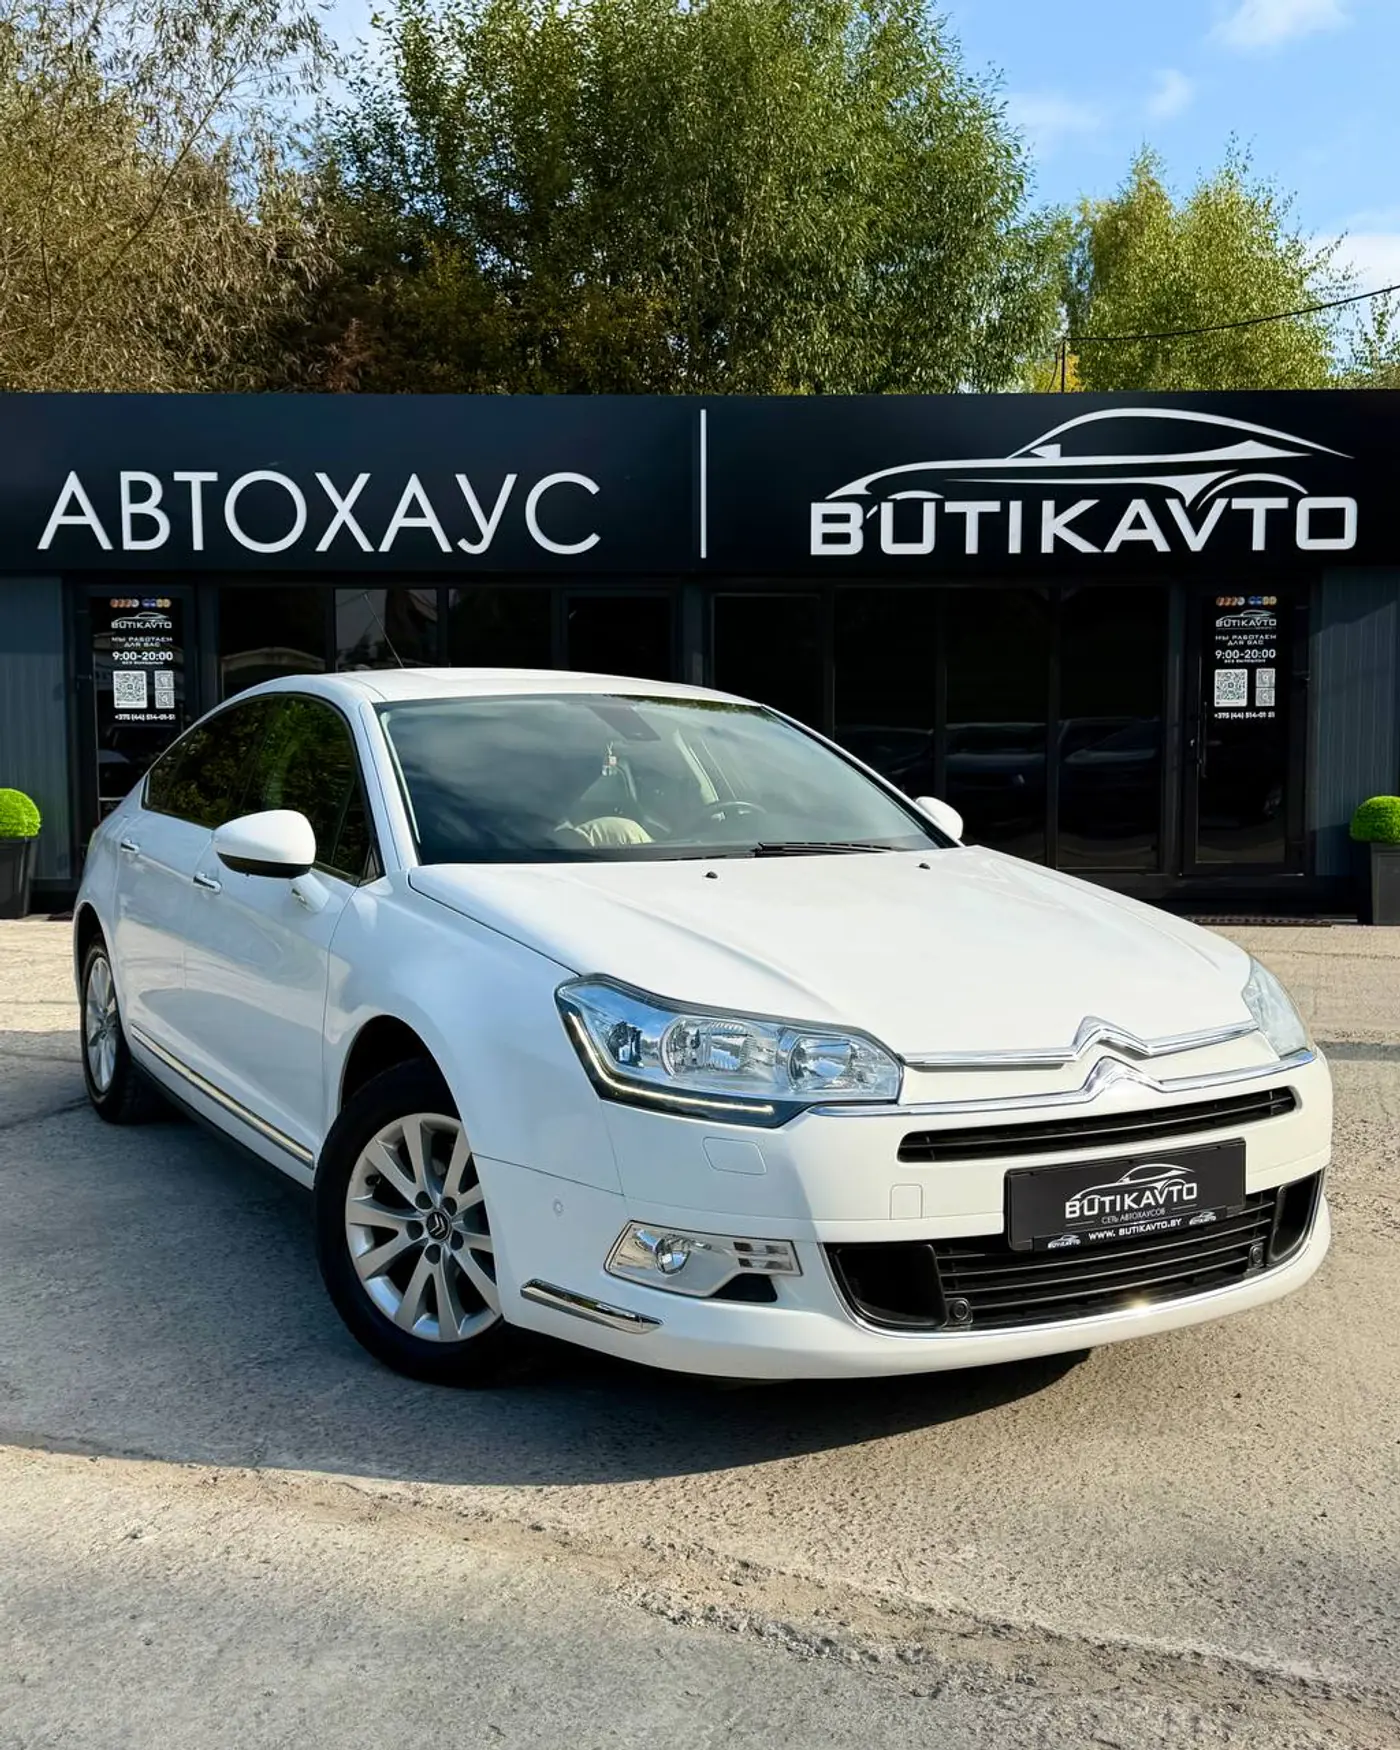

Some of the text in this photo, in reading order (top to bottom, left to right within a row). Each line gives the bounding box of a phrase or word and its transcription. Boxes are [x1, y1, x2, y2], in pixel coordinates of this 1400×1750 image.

[37, 470, 601, 554] АВТОХАУС
[810, 495, 1358, 556] BUTIKAVTO
[111, 620, 172, 629] BUTIKAVTO
[1215, 619, 1277, 628] BUTIKAVTO
[112, 651, 174, 661] 9:00-20:00
[1215, 649, 1277, 660] 9:00-20:00
[1064, 1183, 1198, 1219] BUTIKAVTO
[1101, 1207, 1165, 1225] СЕТЬ АВТОХАУСОВ
[1088, 1229, 1116, 1240] WWW.
